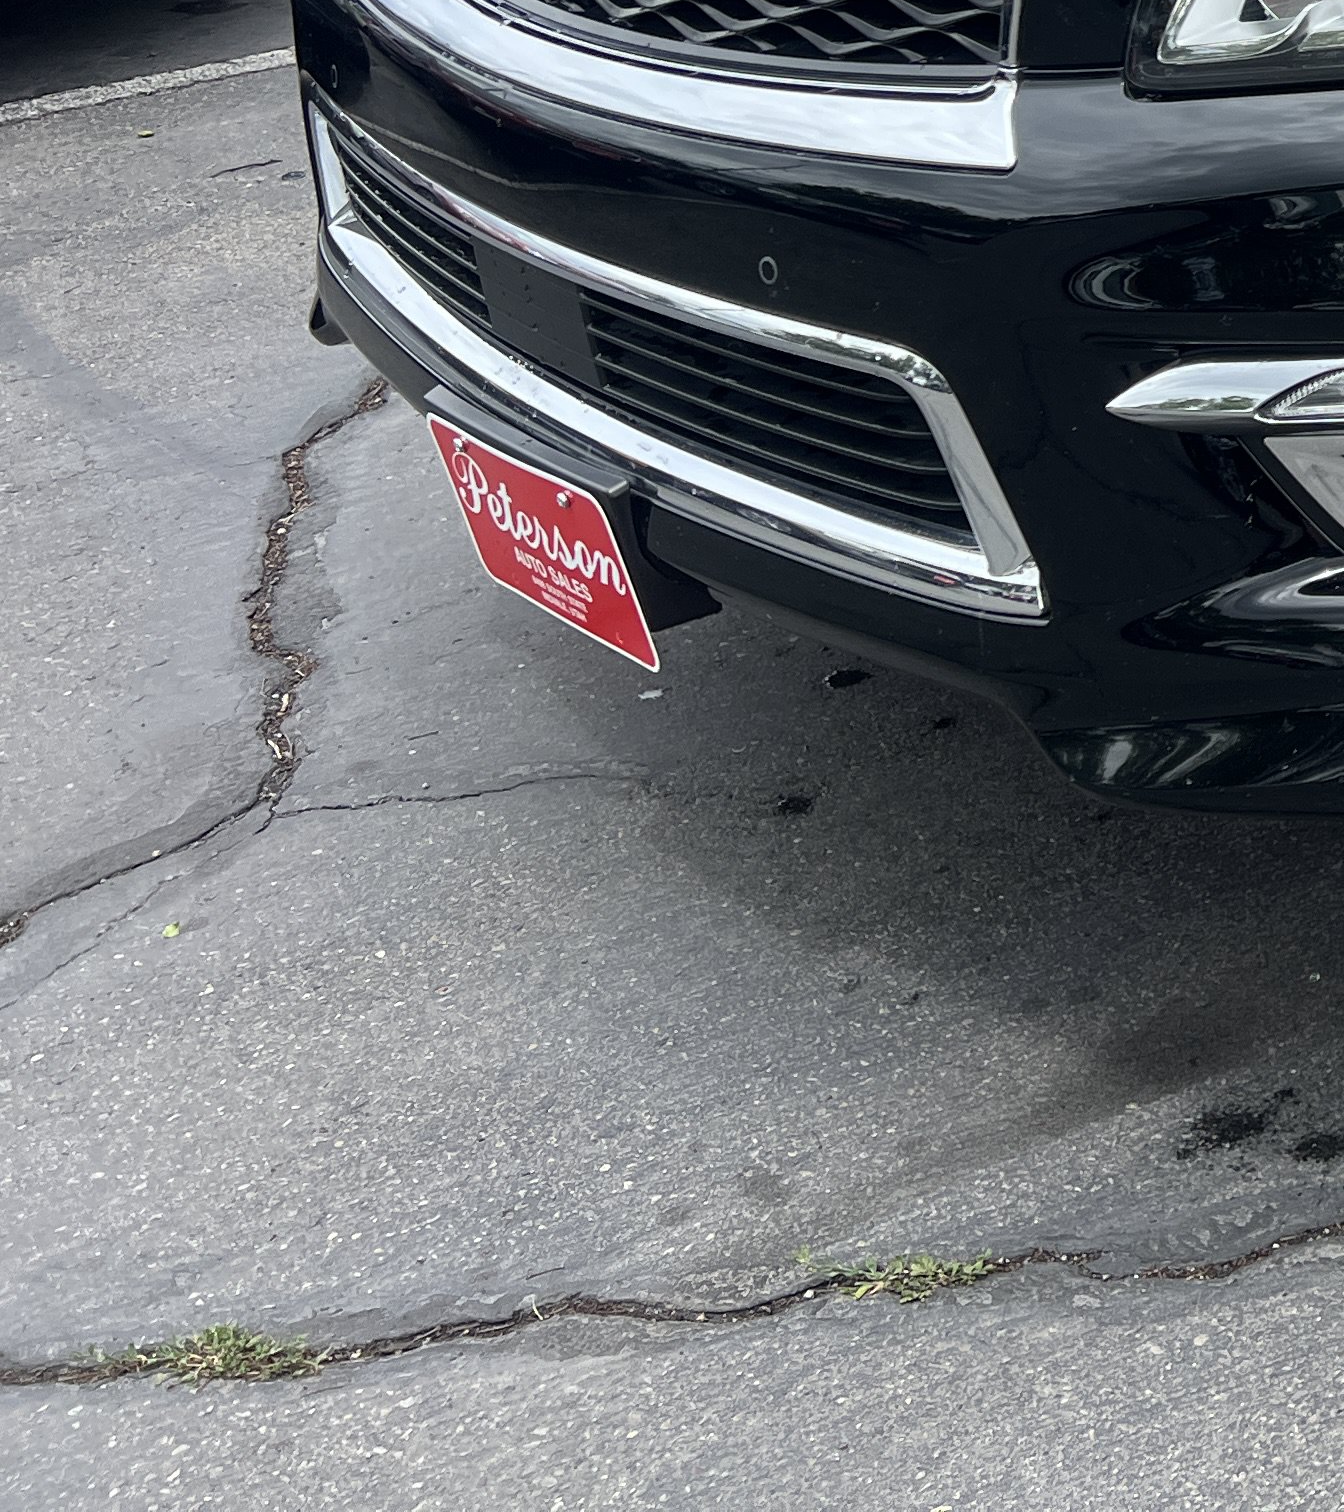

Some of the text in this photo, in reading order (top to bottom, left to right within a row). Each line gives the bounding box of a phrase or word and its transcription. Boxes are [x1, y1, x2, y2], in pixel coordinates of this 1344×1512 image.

[451, 451, 627, 596] Peterson
[513, 545, 548, 579] AUTO
[547, 565, 593, 603] SALES
